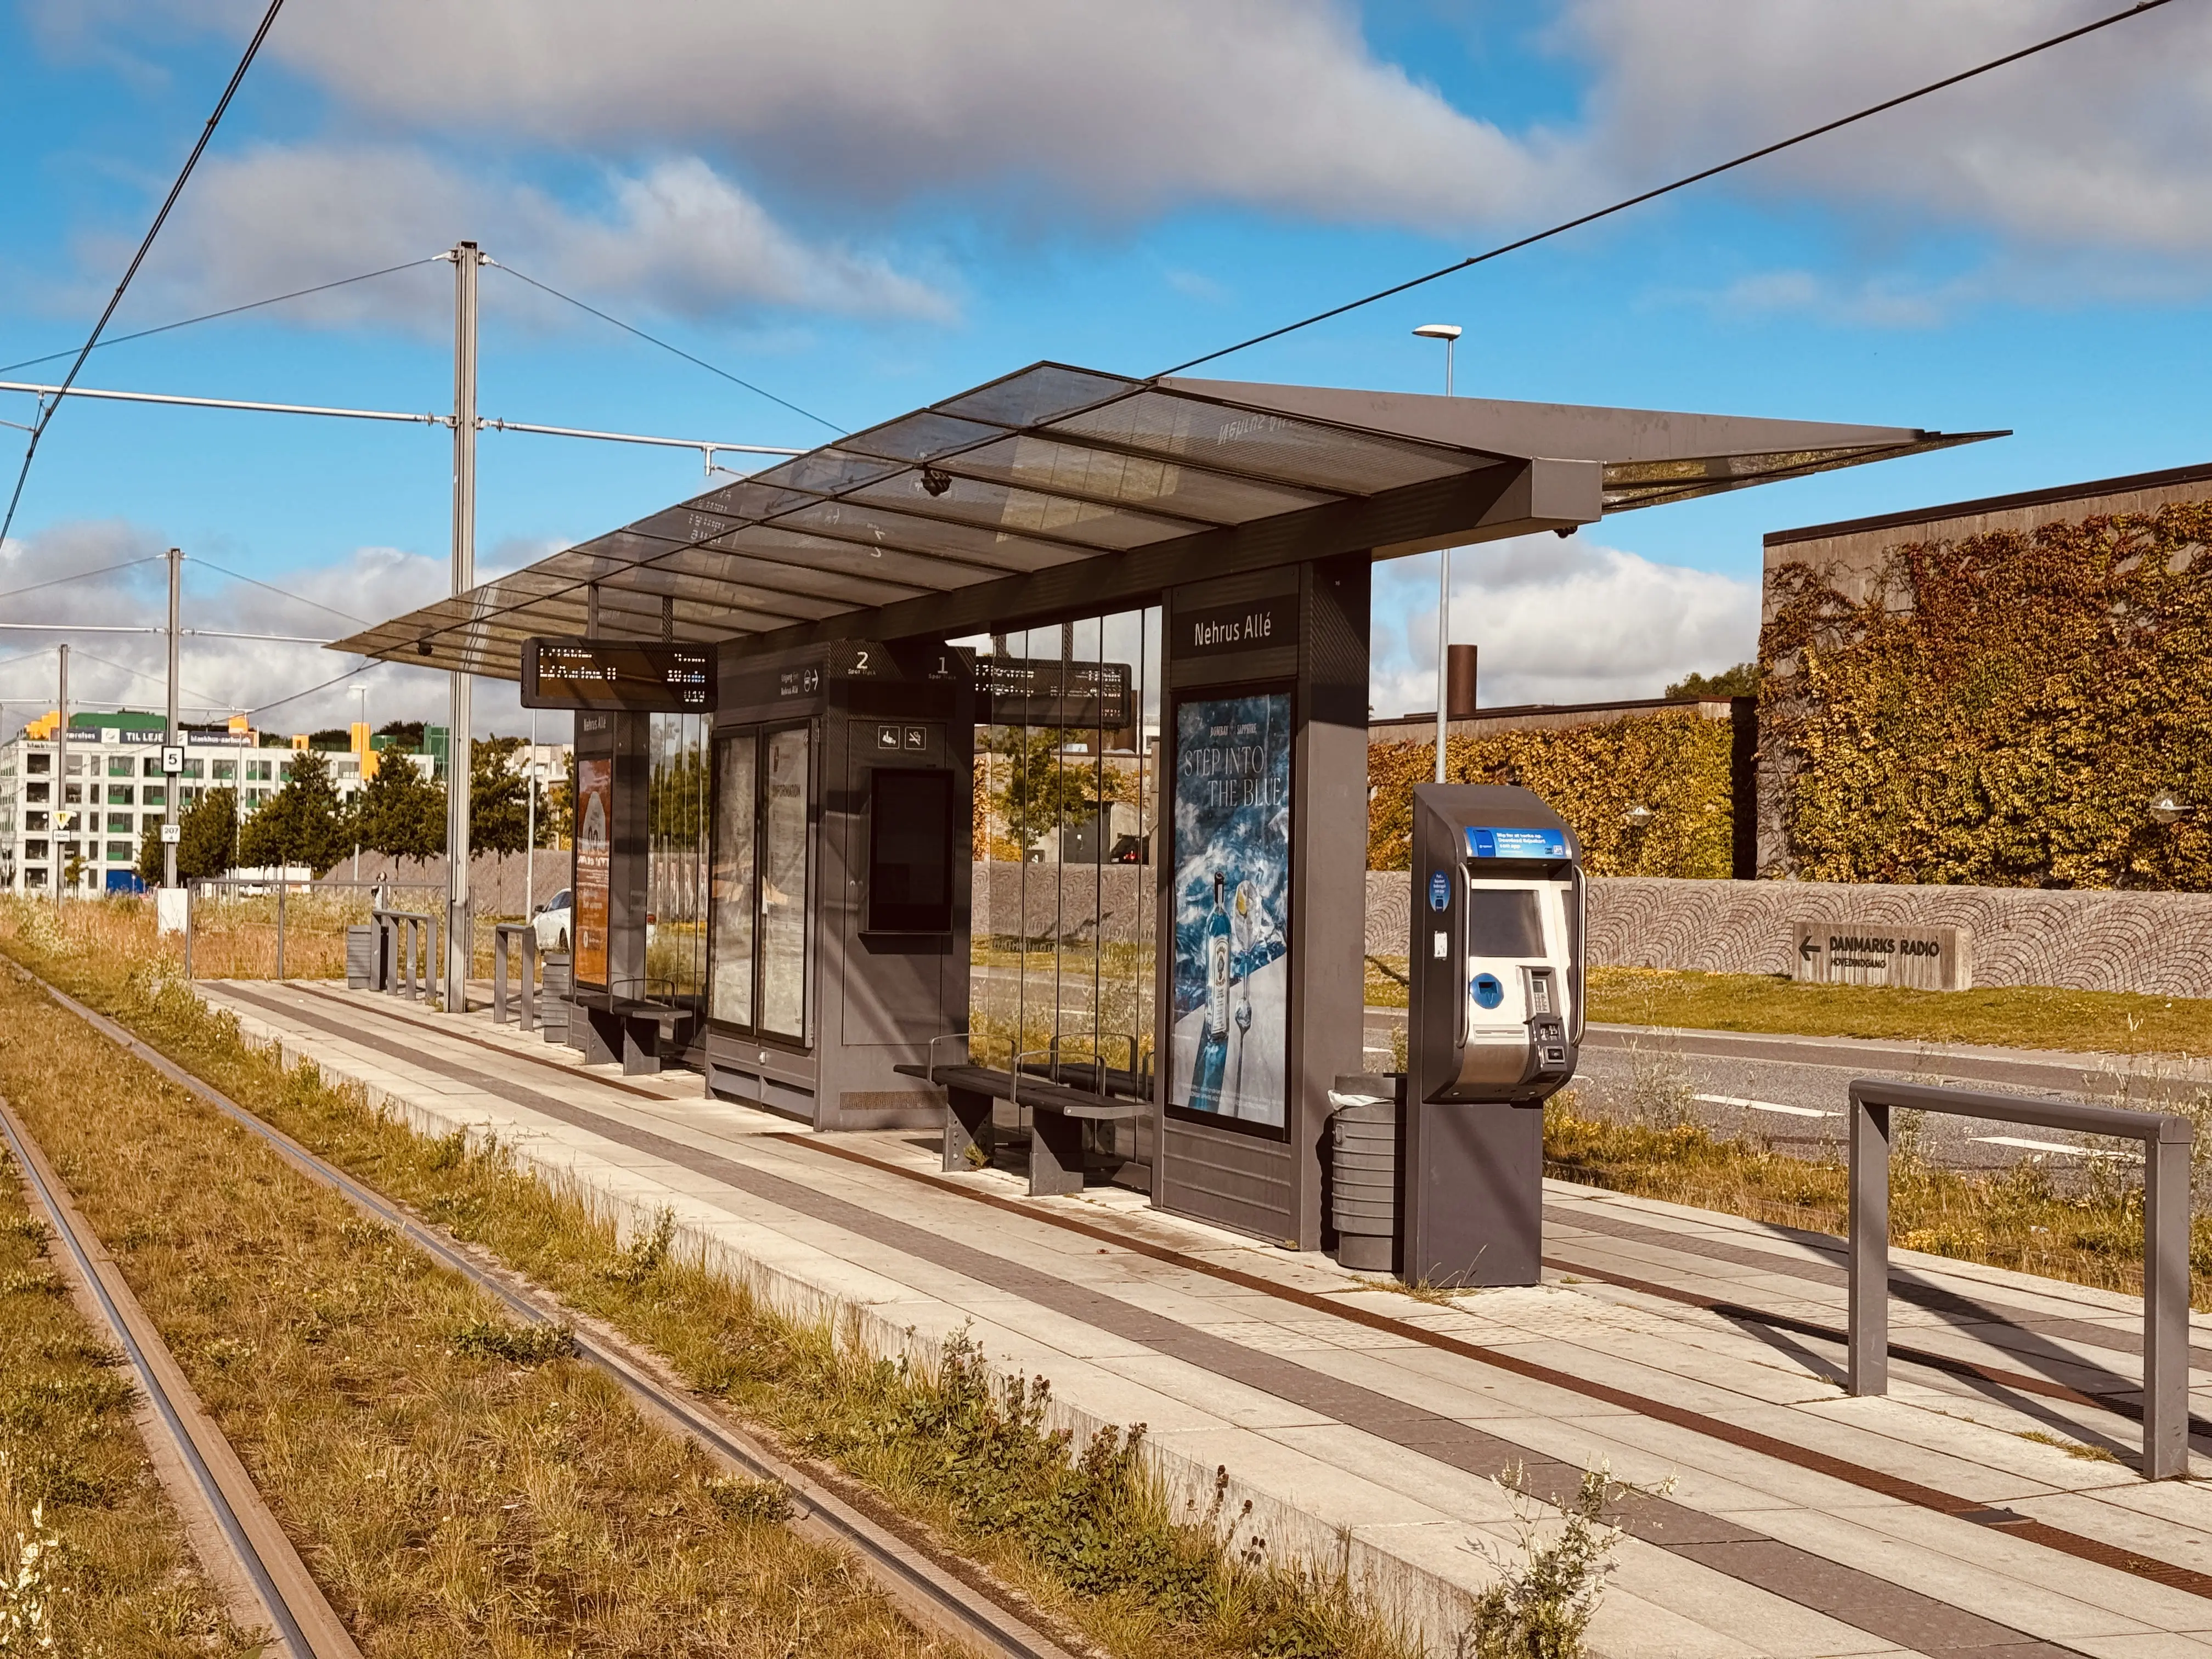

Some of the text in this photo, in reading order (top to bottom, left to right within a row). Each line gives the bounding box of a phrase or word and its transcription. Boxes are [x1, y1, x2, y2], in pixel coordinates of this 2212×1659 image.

[1195, 611, 1271, 646] Nehrus Allé
[856, 651, 868, 669] 2
[937, 657, 949, 674] 1
[584, 718, 597, 732] Nehrus
[1210, 723, 1257, 738] BOMBAY SAPPHIRE
[126, 732, 163, 742] TIL LEJE
[168, 753, 177, 765] 5
[1184, 745, 1265, 777] STEP INTO
[1207, 777, 1282, 808] THE BLUE
[1830, 935, 1940, 957] DANMARKS RADIO
[1830, 957, 1887, 969] HOVEDINDGANG
